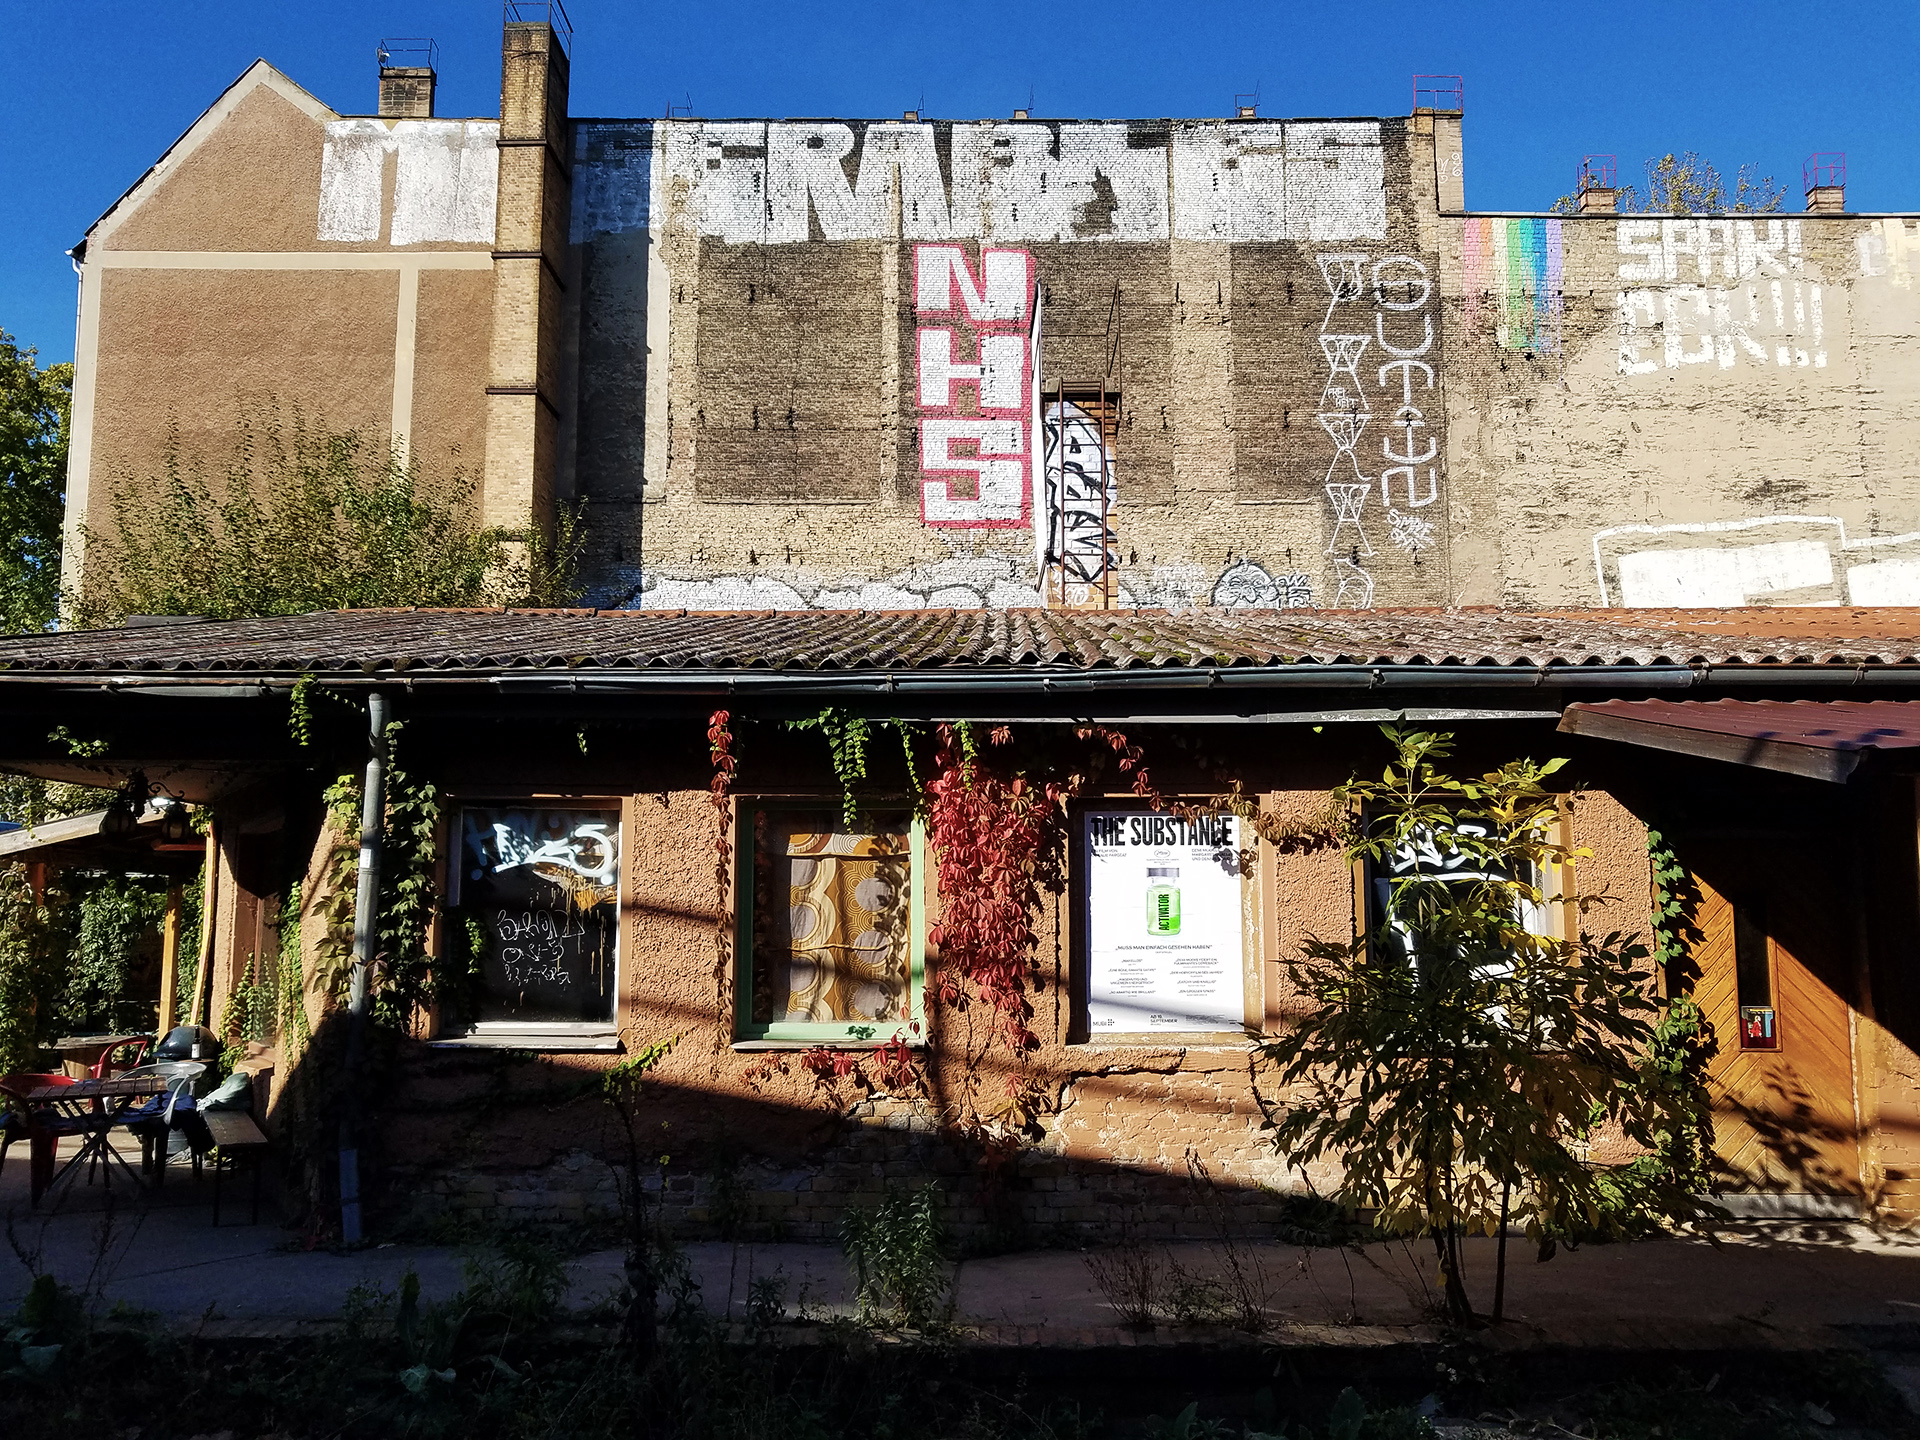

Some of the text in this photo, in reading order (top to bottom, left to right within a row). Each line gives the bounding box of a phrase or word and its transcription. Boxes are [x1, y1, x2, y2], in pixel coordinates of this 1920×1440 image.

[1091, 816, 1233, 847] THE SUBSTANCE
[1158, 894, 1170, 931] ACTIVATOR
